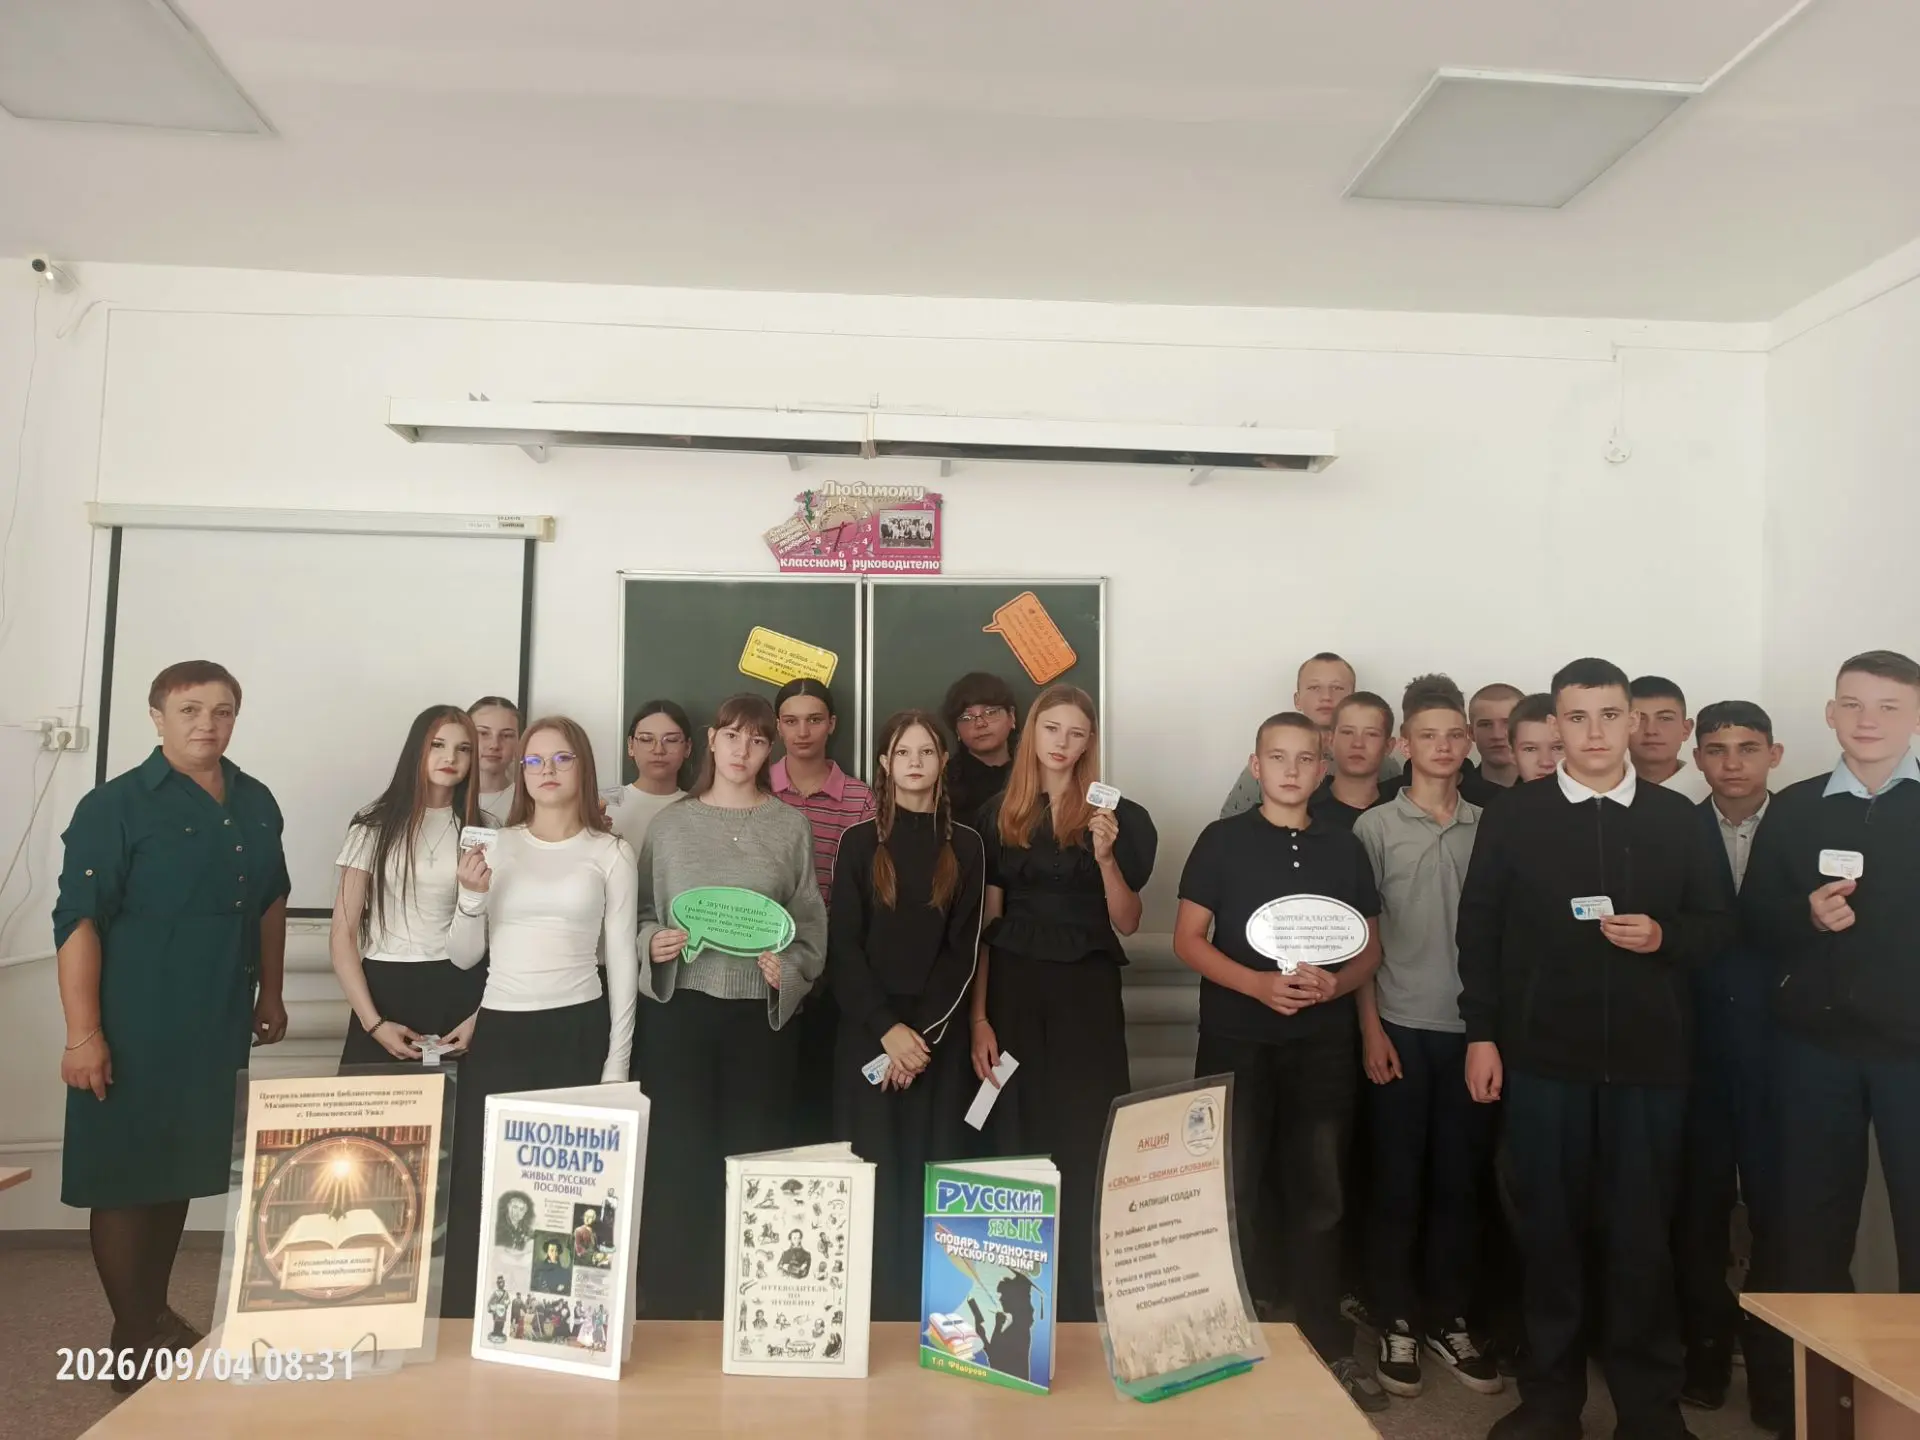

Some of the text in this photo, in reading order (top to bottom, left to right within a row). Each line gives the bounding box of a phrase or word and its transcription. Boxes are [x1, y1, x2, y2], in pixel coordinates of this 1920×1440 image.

[822, 480, 925, 500] Любимому
[865, 524, 872, 533] 3
[815, 536, 821, 545] 8
[780, 557, 940, 571] классному руководителю
[838, 551, 845, 559] 6
[504, 1119, 620, 1152] ШКОЛЬНЫЙ
[1138, 1133, 1170, 1150] АКЦИЯ
[517, 1144, 604, 1174] СЛОВАРЬ
[521, 1169, 597, 1187] ЖИВЫХ РУССКИХ
[533, 1181, 583, 1197] ПОСЛОВИЦ
[936, 1178, 1044, 1213] РУССКИЙ
[1139, 1188, 1202, 1209] НАПИШИ СОЛДАТУ
[988, 1217, 1043, 1244] ЯЗЫК
[935, 1231, 1048, 1264] СЛОВАРЬ ТРУДНОСТЕЙ
[946, 1245, 1034, 1271] РУССКОГО ЯЗЫКА
